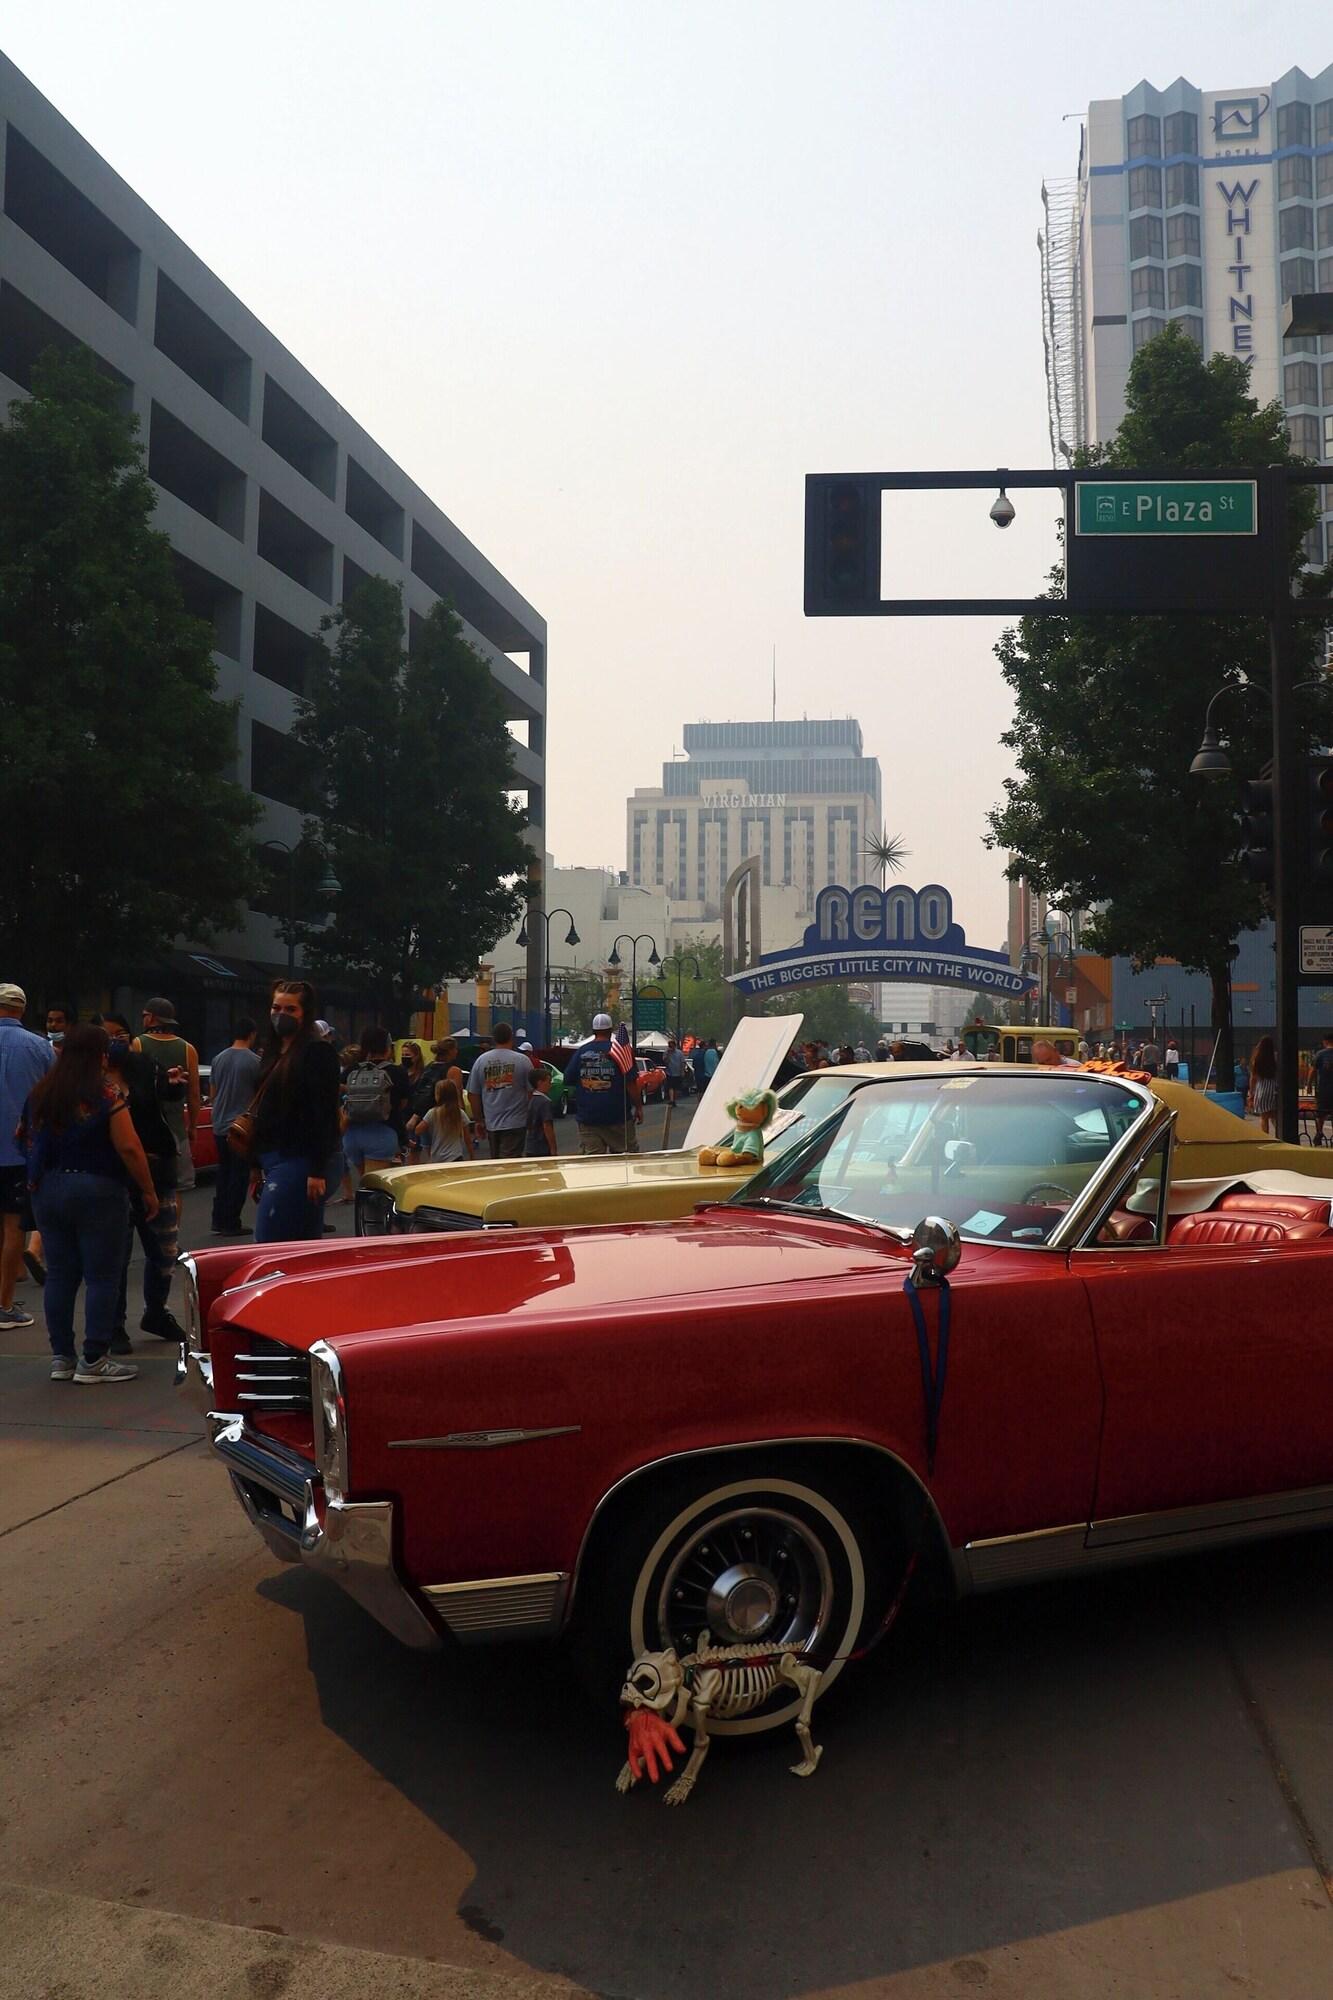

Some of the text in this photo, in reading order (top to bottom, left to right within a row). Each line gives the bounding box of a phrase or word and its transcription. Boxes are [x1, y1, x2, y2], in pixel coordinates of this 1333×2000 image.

[1215, 148, 1260, 157] HOTEL
[1122, 495, 1234, 522] E Plaza St
[702, 793, 787, 809] VIRGINIAN
[819, 889, 949, 941] RENO
[748, 959, 1023, 991] THE BIGGEST LITTLE CITY IN THE WORLD
